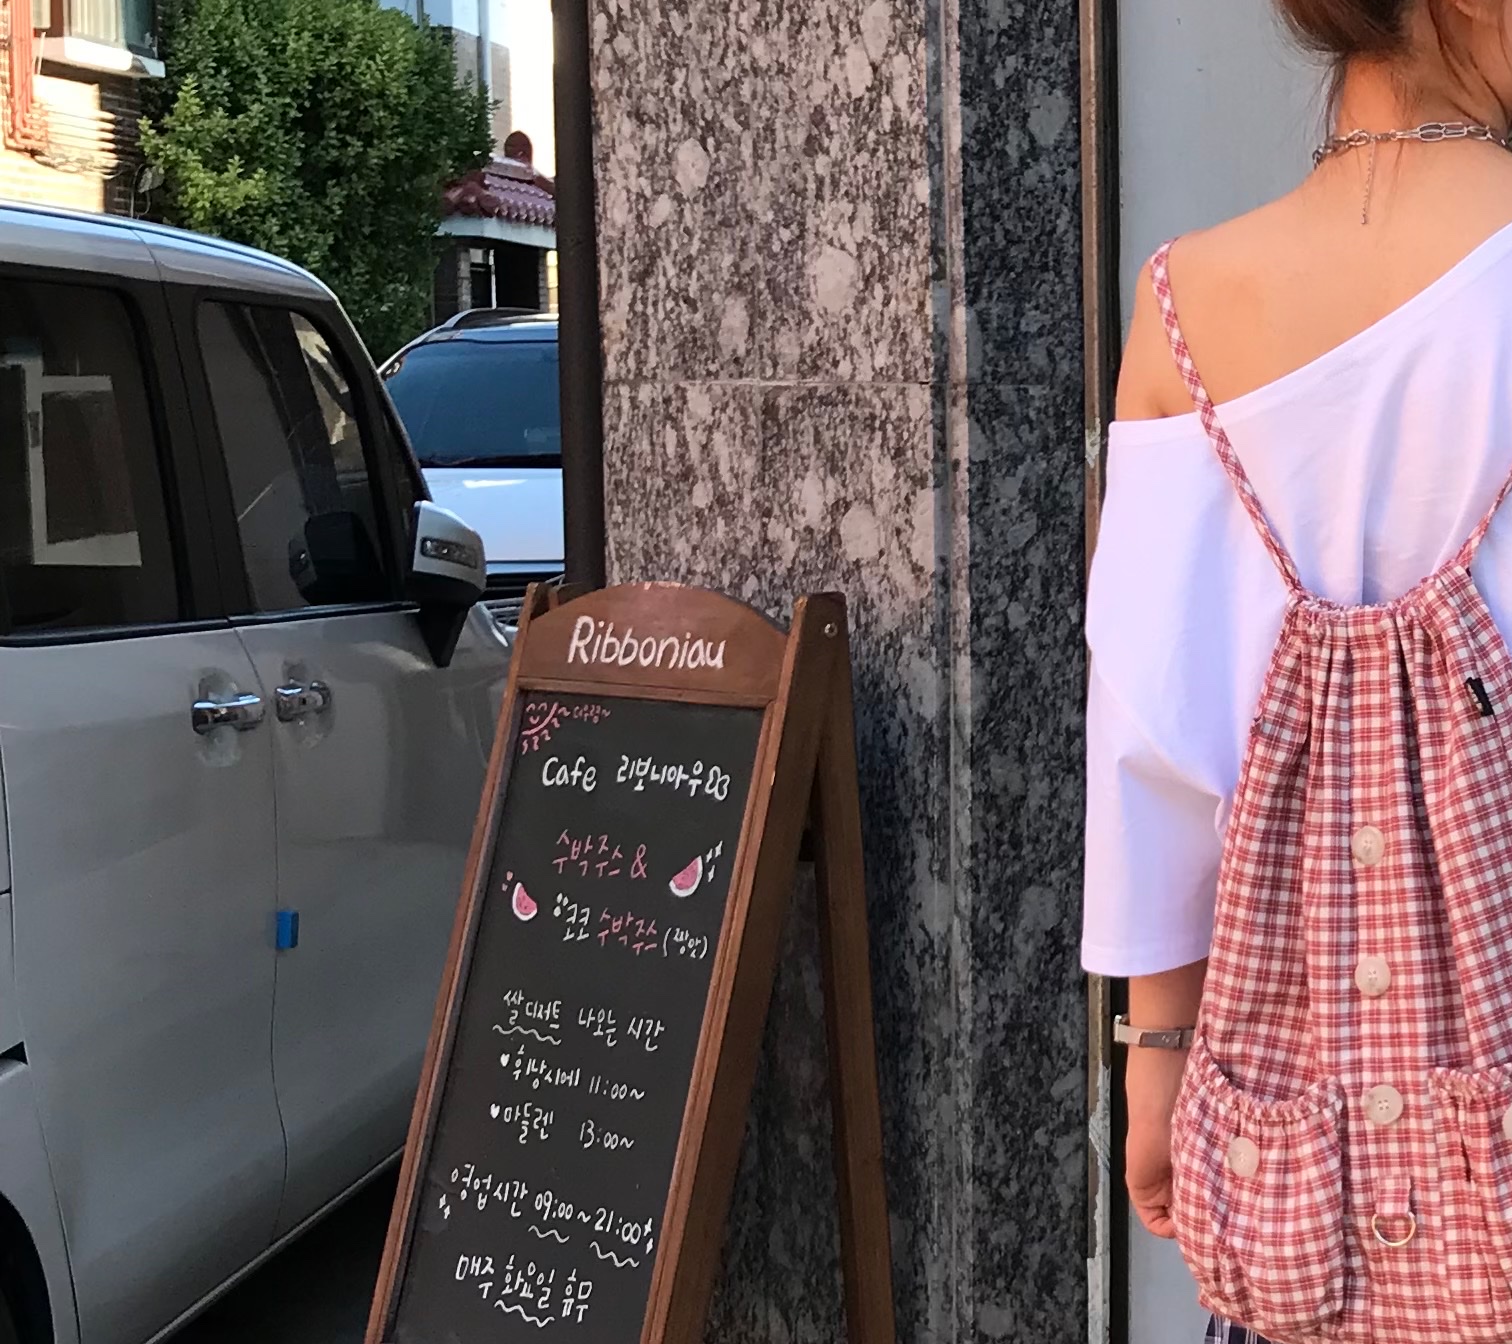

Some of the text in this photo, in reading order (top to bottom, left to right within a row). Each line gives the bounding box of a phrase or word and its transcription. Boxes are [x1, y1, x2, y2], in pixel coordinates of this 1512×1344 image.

[567, 615, 726, 669] Ribboniau
[542, 757, 597, 792] Cafe
[552, 829, 648, 879] 수박주스 &
[598, 908, 658, 956] 수박주스
[578, 1007, 617, 1047] 나오는
[627, 1016, 665, 1052] 시간
[513, 1044, 645, 1100] 휘낭시에 11:00~
[503, 1102, 635, 1150] 마들렌 13:00~
[455, 1254, 593, 1323] 매주 화요일 휴무
